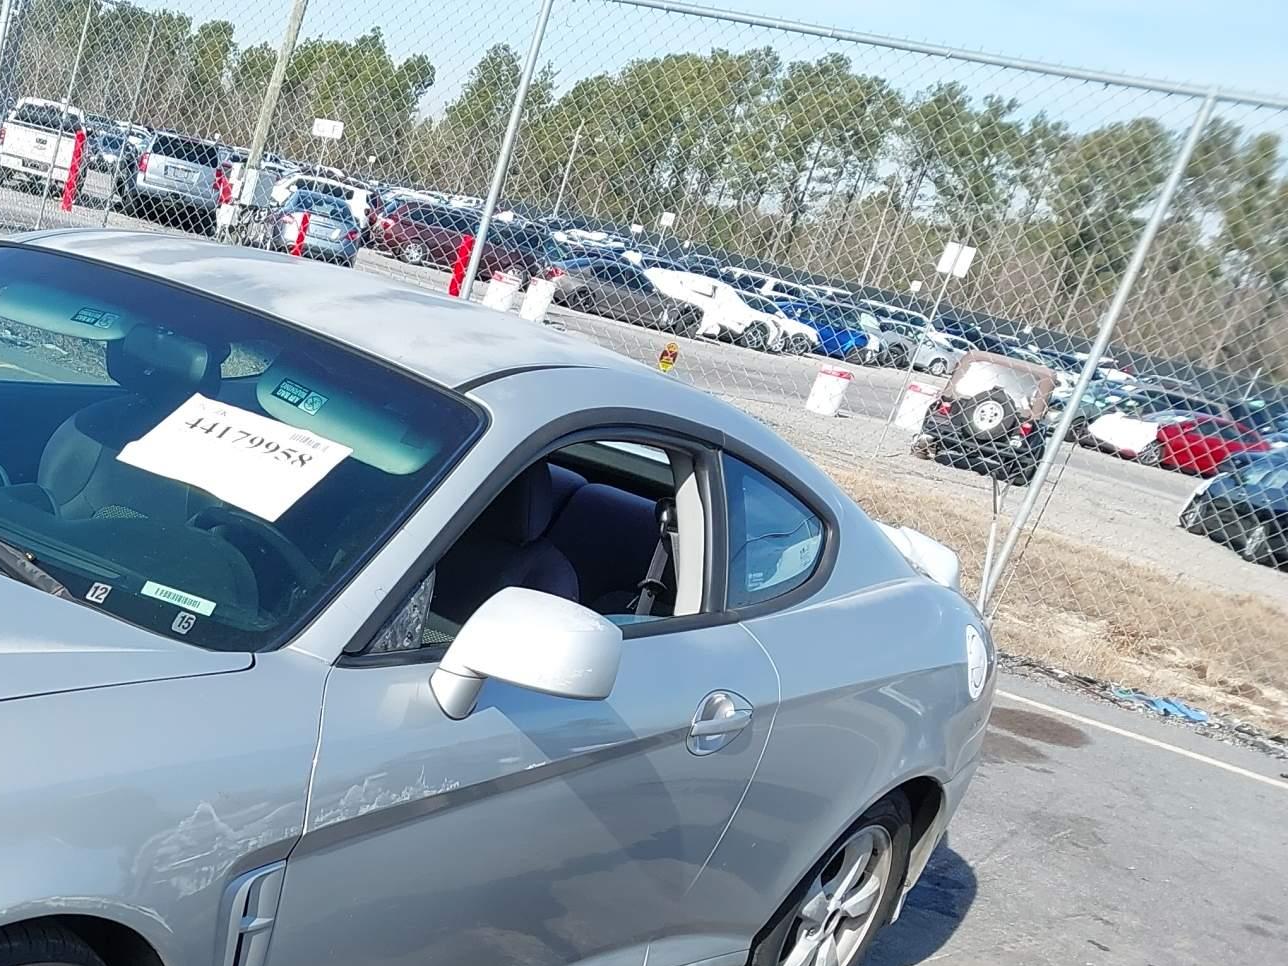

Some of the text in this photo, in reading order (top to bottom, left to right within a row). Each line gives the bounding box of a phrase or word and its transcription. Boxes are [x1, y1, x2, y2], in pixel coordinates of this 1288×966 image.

[184, 417, 313, 468] 44179958
[91, 585, 109, 601] 12
[176, 614, 194, 630] 15
